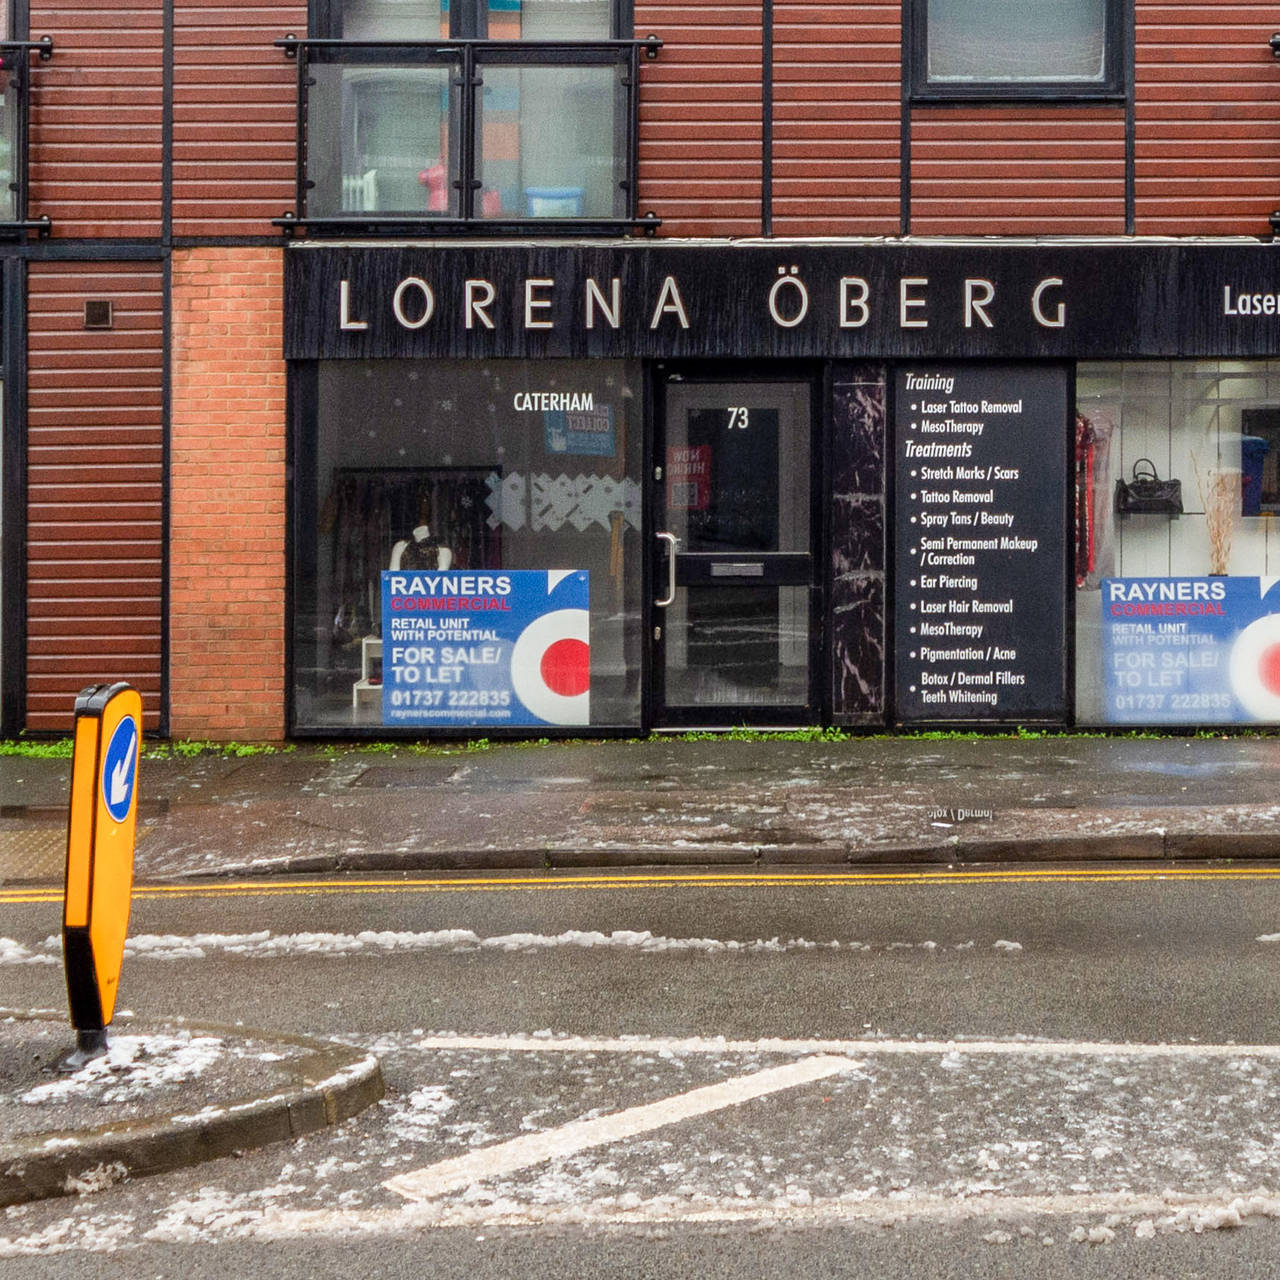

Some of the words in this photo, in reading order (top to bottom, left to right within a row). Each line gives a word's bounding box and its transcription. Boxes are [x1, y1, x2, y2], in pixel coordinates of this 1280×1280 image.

[338, 276, 690, 330] LORENA
[768, 266, 1066, 328] ÖBERG
[906, 373, 954, 393] Training
[514, 393, 593, 411] CATERHAM
[921, 401, 947, 413] Laser
[950, 401, 978, 413] Tattoo
[981, 400, 1022, 413] Removal
[727, 407, 749, 429] 73
[921, 420, 984, 435] MesoTherapy
[905, 441, 972, 458] Treatments
[921, 467, 953, 480] Stretch
[956, 467, 985, 480] Marks
[987, 467, 992, 481] /
[994, 467, 1019, 479] Scars
[921, 490, 950, 503] Tattoo
[953, 490, 993, 503] Removal
[921, 513, 947, 527] Spray
[950, 513, 971, 525] Tans
[973, 512, 979, 526] /
[981, 513, 1014, 527] Beauty
[921, 537, 944, 550] Semi
[947, 538, 998, 550] Permanent
[1000, 537, 1038, 552] Makeup
[921, 553, 925, 566] /
[928, 553, 975, 565] Correction
[390, 576, 512, 595] RAYNERS
[921, 576, 936, 588] Ear
[939, 576, 978, 591] Piercing
[1110, 582, 1226, 601] RAYNERS
[391, 598, 511, 611] COMMERCIAL
[921, 601, 946, 613] Laser
[949, 601, 969, 613] Hair
[972, 600, 1013, 613] Removal
[1111, 603, 1226, 616] COMMERCIAL
[392, 619, 436, 629] RETAIL
[440, 618, 469, 629] UNIT
[920, 622, 983, 638] MesoTherapy
[1113, 624, 1155, 634] RETAIL
[1159, 623, 1186, 633] UNIT
[392, 631, 424, 641] WITH
[428, 631, 500, 641] POTENTIAL
[1113, 635, 1143, 645] WITH
[1148, 635, 1216, 645] POTENTIAL
[393, 648, 437, 663] FOR
[441, 647, 501, 664] SALE/
[921, 647, 983, 663] Pigmentation
[986, 647, 991, 661] /
[993, 648, 1016, 660] Acne
[1115, 653, 1156, 668] FOR
[1162, 652, 1219, 667] SALE/
[392, 667, 421, 683] TO
[427, 667, 464, 683] LET
[922, 672, 948, 685] Botox
[950, 672, 955, 686] /
[958, 672, 993, 685] Dermal
[996, 672, 1025, 684] Fillers
[1115, 671, 1142, 687] TO
[1148, 671, 1184, 686] LET
[392, 692, 442, 706] 01737
[449, 691, 510, 706] 222835
[921, 691, 946, 703] Teeth
[950, 691, 998, 705] Whitening
[1116, 694, 1164, 709] 01737
[1172, 693, 1231, 708] 222835
[391, 709, 511, 719] raynerscommercial.com
